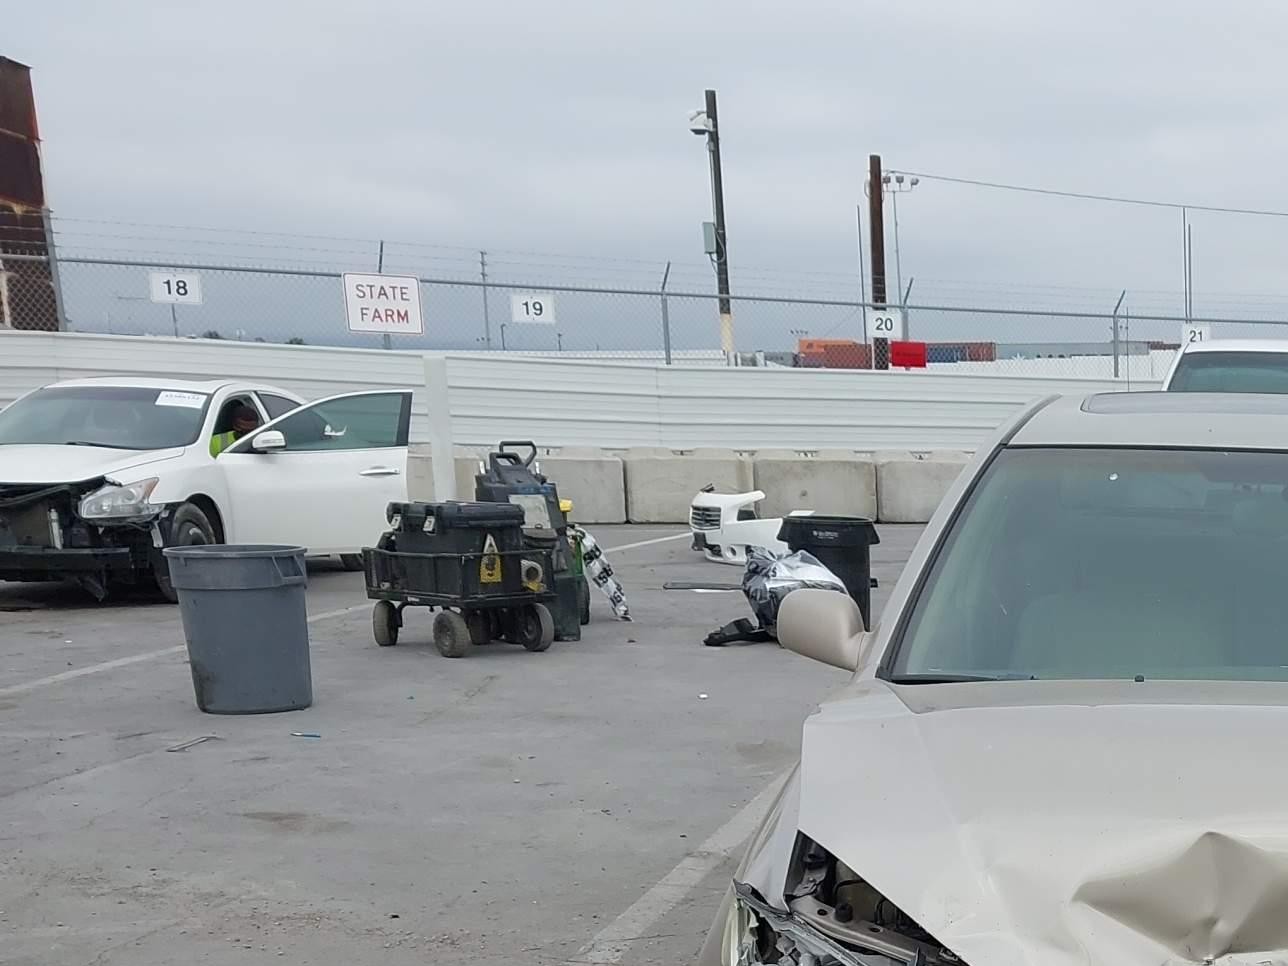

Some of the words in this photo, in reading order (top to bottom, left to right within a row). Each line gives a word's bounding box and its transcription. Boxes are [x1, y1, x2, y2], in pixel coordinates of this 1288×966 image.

[163, 279, 188, 297] 18
[355, 284, 411, 301] STATE
[360, 307, 410, 324] FARM
[522, 301, 543, 316] 19
[875, 317, 893, 331] 20
[1190, 330, 1203, 342] 21
